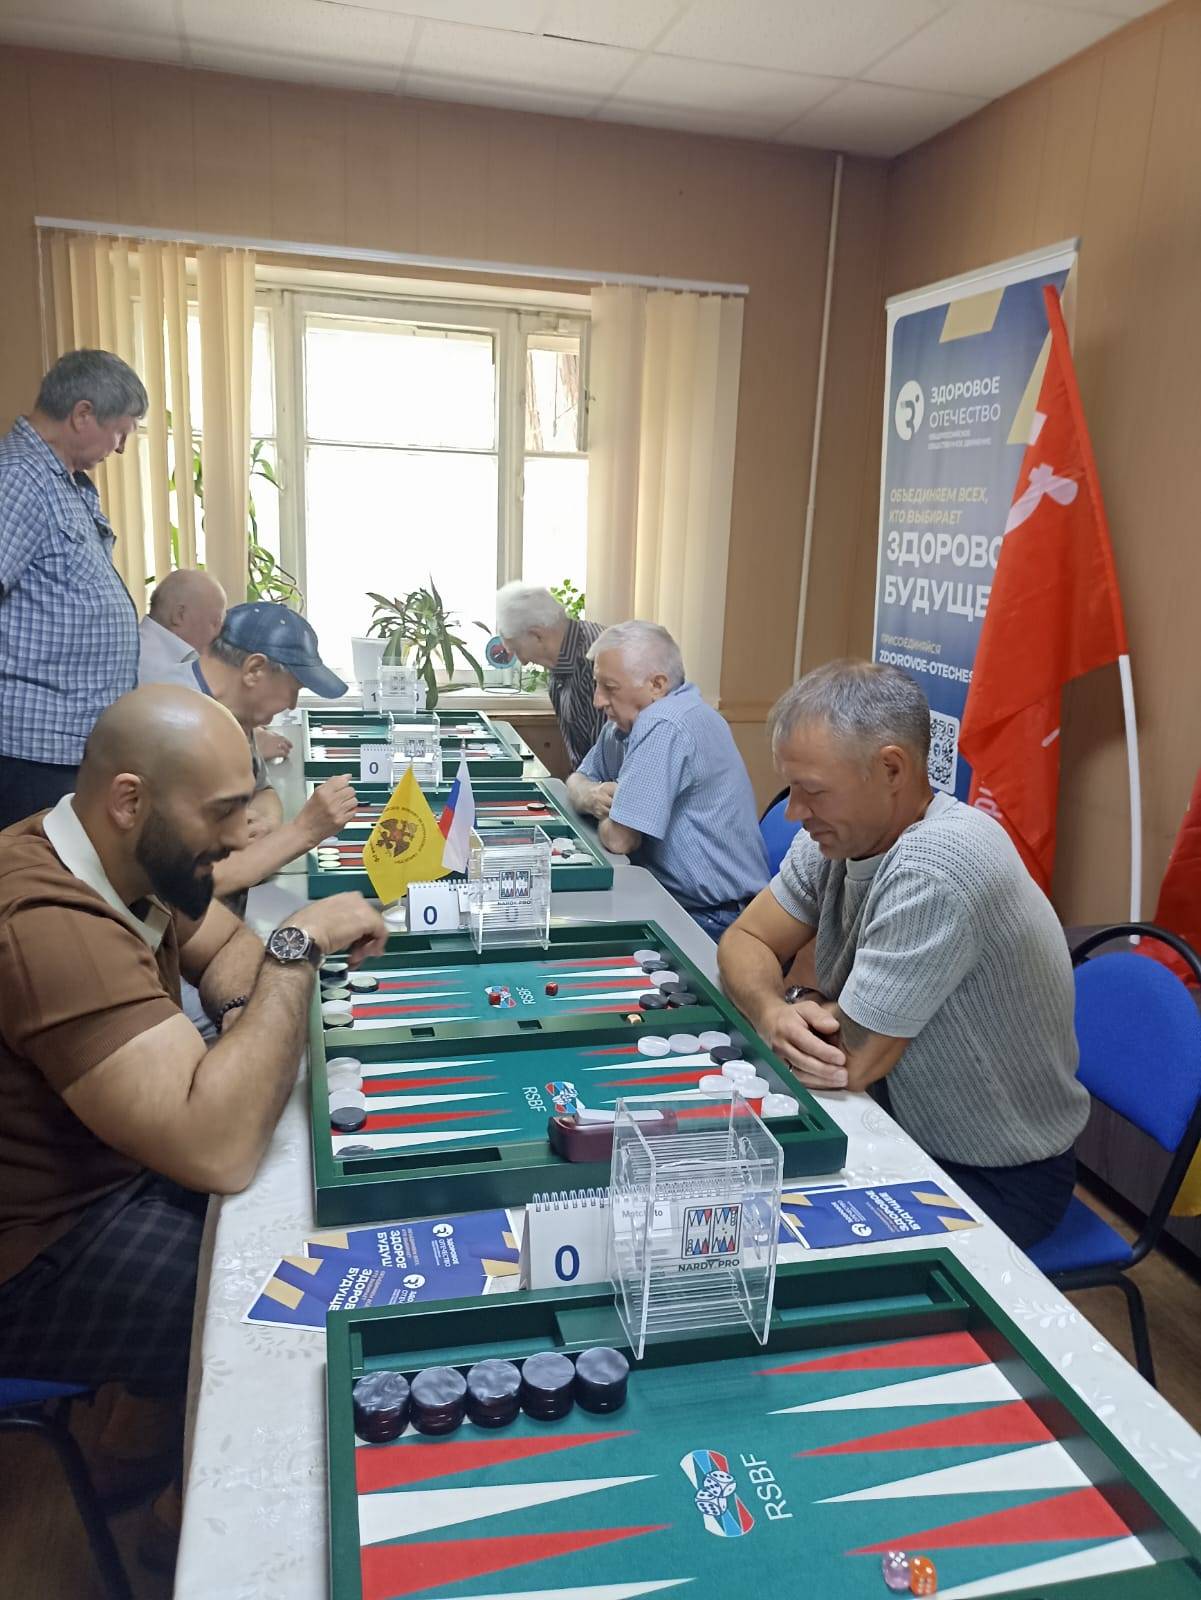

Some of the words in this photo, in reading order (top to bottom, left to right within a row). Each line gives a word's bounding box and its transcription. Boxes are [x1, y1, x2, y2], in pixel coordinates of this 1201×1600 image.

[930, 376, 1000, 405] ЗДОРОВОЕ
[929, 404, 1001, 428] ОТЕЧЕСТВО
[907, 510, 963, 525] ВЫБИРАЕТ
[884, 574, 992, 622] БУДУЩЕ
[369, 762, 379, 774] 0
[423, 905, 438, 925] 0
[522, 1086, 547, 1113] RSBF
[555, 1244, 580, 1281] 0
[678, 1261, 715, 1272] NARDY
[718, 1259, 740, 1268] PRO
[740, 1452, 793, 1521] RSBF
